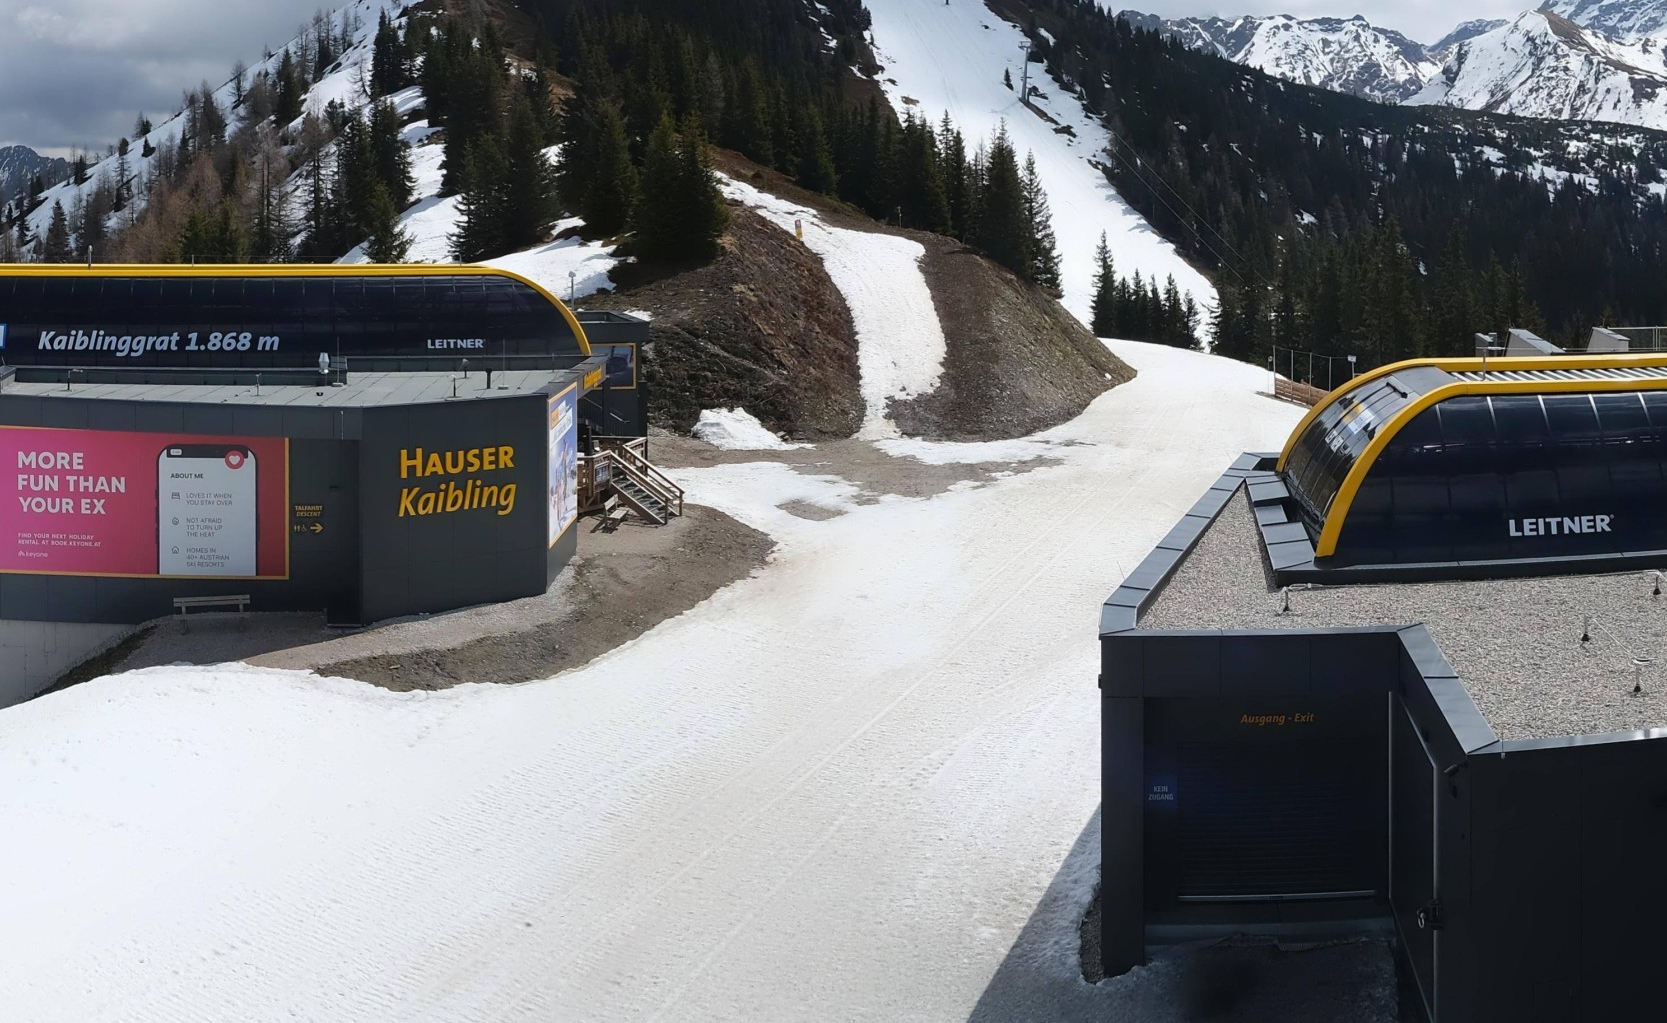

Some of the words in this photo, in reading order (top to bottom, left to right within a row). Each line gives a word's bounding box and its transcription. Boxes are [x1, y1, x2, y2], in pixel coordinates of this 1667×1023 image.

[38, 330, 178, 356] Kaiblinggrat
[185, 332, 251, 350] 1.868
[256, 335, 280, 350] m
[427, 338, 484, 348] LEITNER
[18, 451, 84, 470] MORE
[400, 446, 515, 478] HAUSER
[18, 474, 58, 491] FUN
[66, 476, 126, 493] THAN
[18, 497, 74, 513] YOUR
[81, 498, 106, 514] EX
[398, 479, 517, 518] Kaibling
[1508, 515, 1612, 536] LEITNER
[1240, 714, 1286, 726] Ausgang
[1294, 712, 1314, 722] Exit
